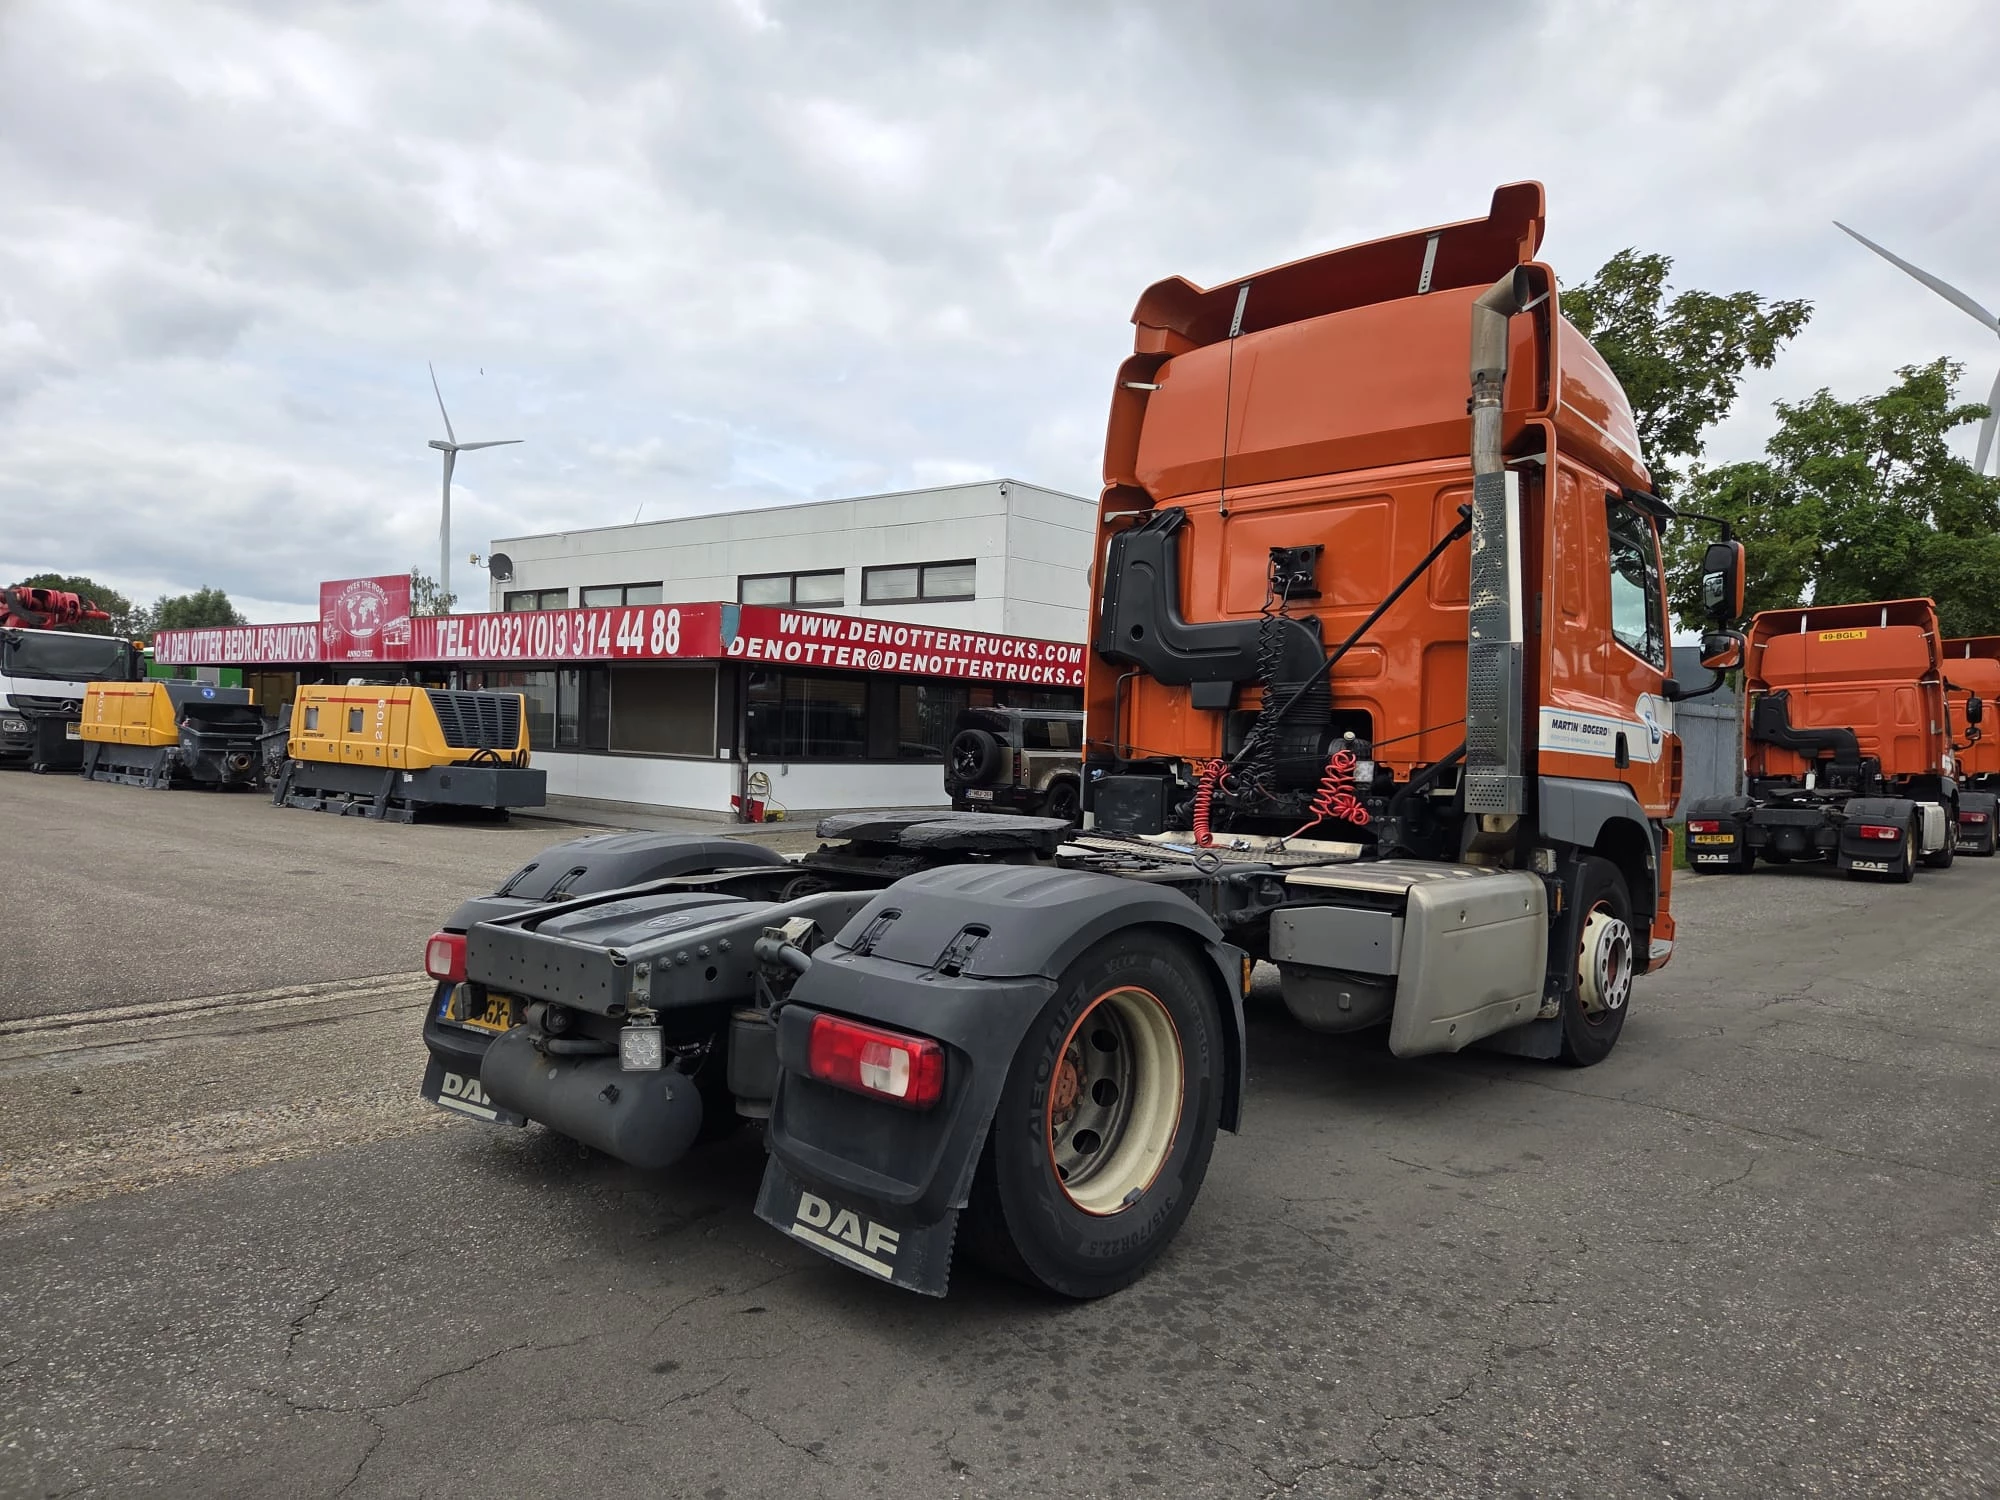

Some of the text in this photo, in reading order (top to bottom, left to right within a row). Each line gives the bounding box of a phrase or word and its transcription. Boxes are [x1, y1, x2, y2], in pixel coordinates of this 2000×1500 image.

[347, 582, 360, 593] OVER
[361, 580, 371, 589] THE
[171, 631, 190, 662] DEN
[191, 630, 222, 662] OTTER
[224, 626, 317, 661] BEDRIJFSAUTO'S
[436, 619, 473, 657] TEL:
[478, 616, 522, 657] 0032
[572, 612, 611, 656] 314
[616, 609, 645, 655] 44
[651, 608, 681, 655] 88
[779, 612, 1082, 664] WWW.DENOTTERTRUCKS.COM
[1822, 631, 1863, 640] 49-BGL-1
[727, 636, 1086, 686] DENOTTER@DENOTTERTRUCKS.C
[1551, 718, 1579, 732] MARTIN
[1851, 860, 1889, 869] DAF
[441, 1071, 491, 1105] DA
[796, 1191, 900, 1255] DAF
